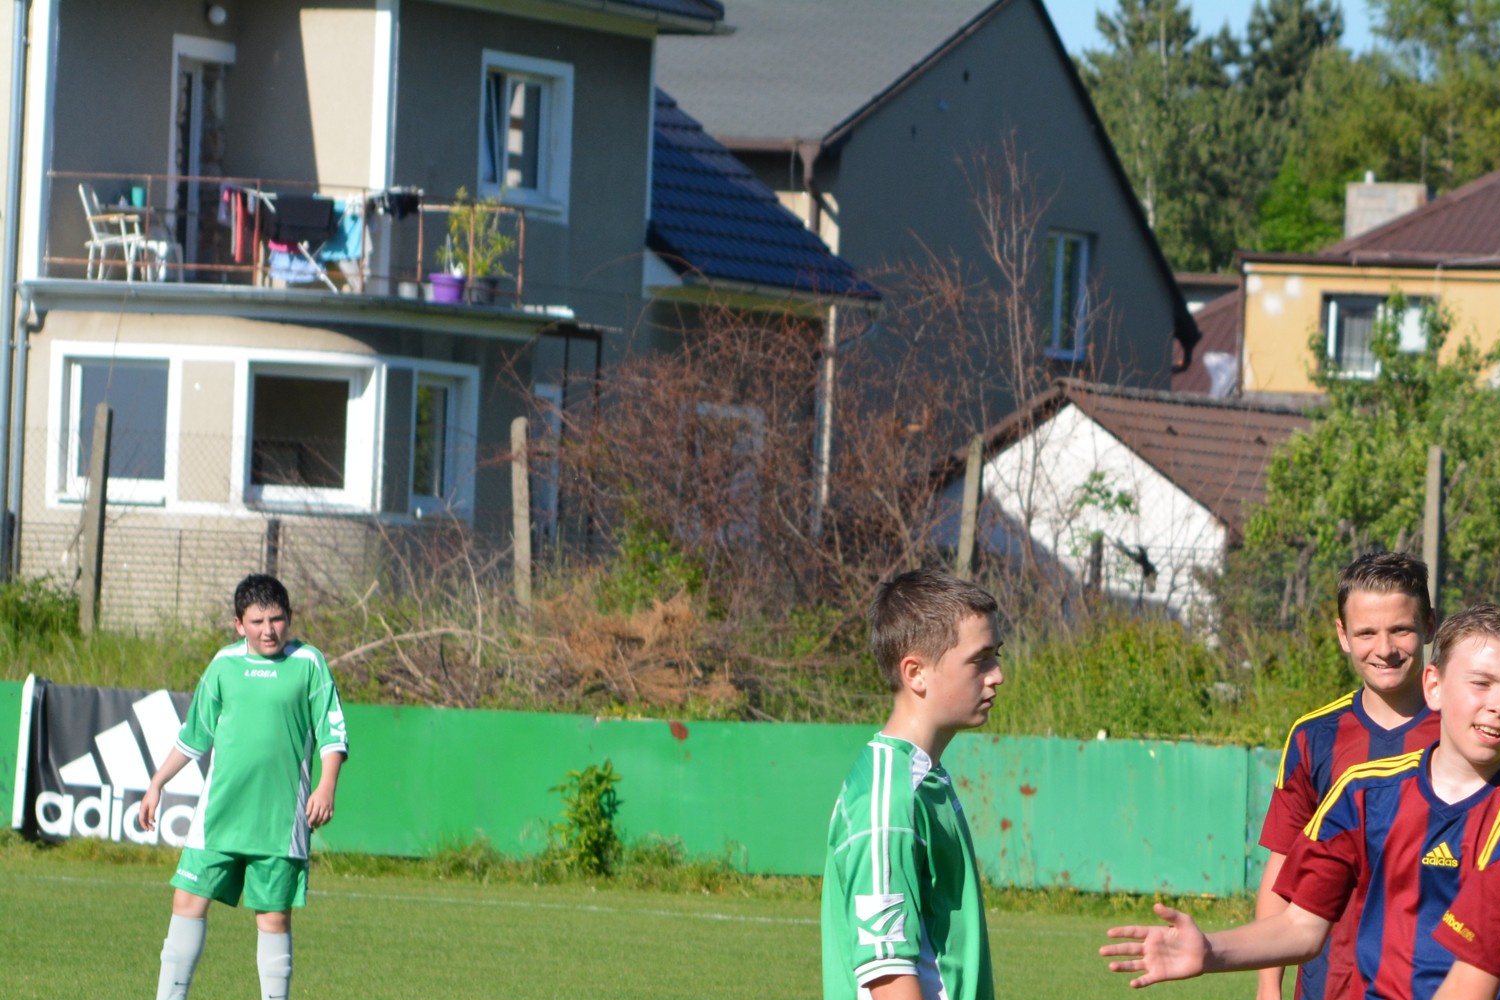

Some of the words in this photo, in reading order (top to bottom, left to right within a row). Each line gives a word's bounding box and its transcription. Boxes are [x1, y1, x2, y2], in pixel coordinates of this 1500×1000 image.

[244, 668, 278, 679] LEGEA
[35, 784, 198, 849] adida
[1421, 855, 1459, 867] adidas
